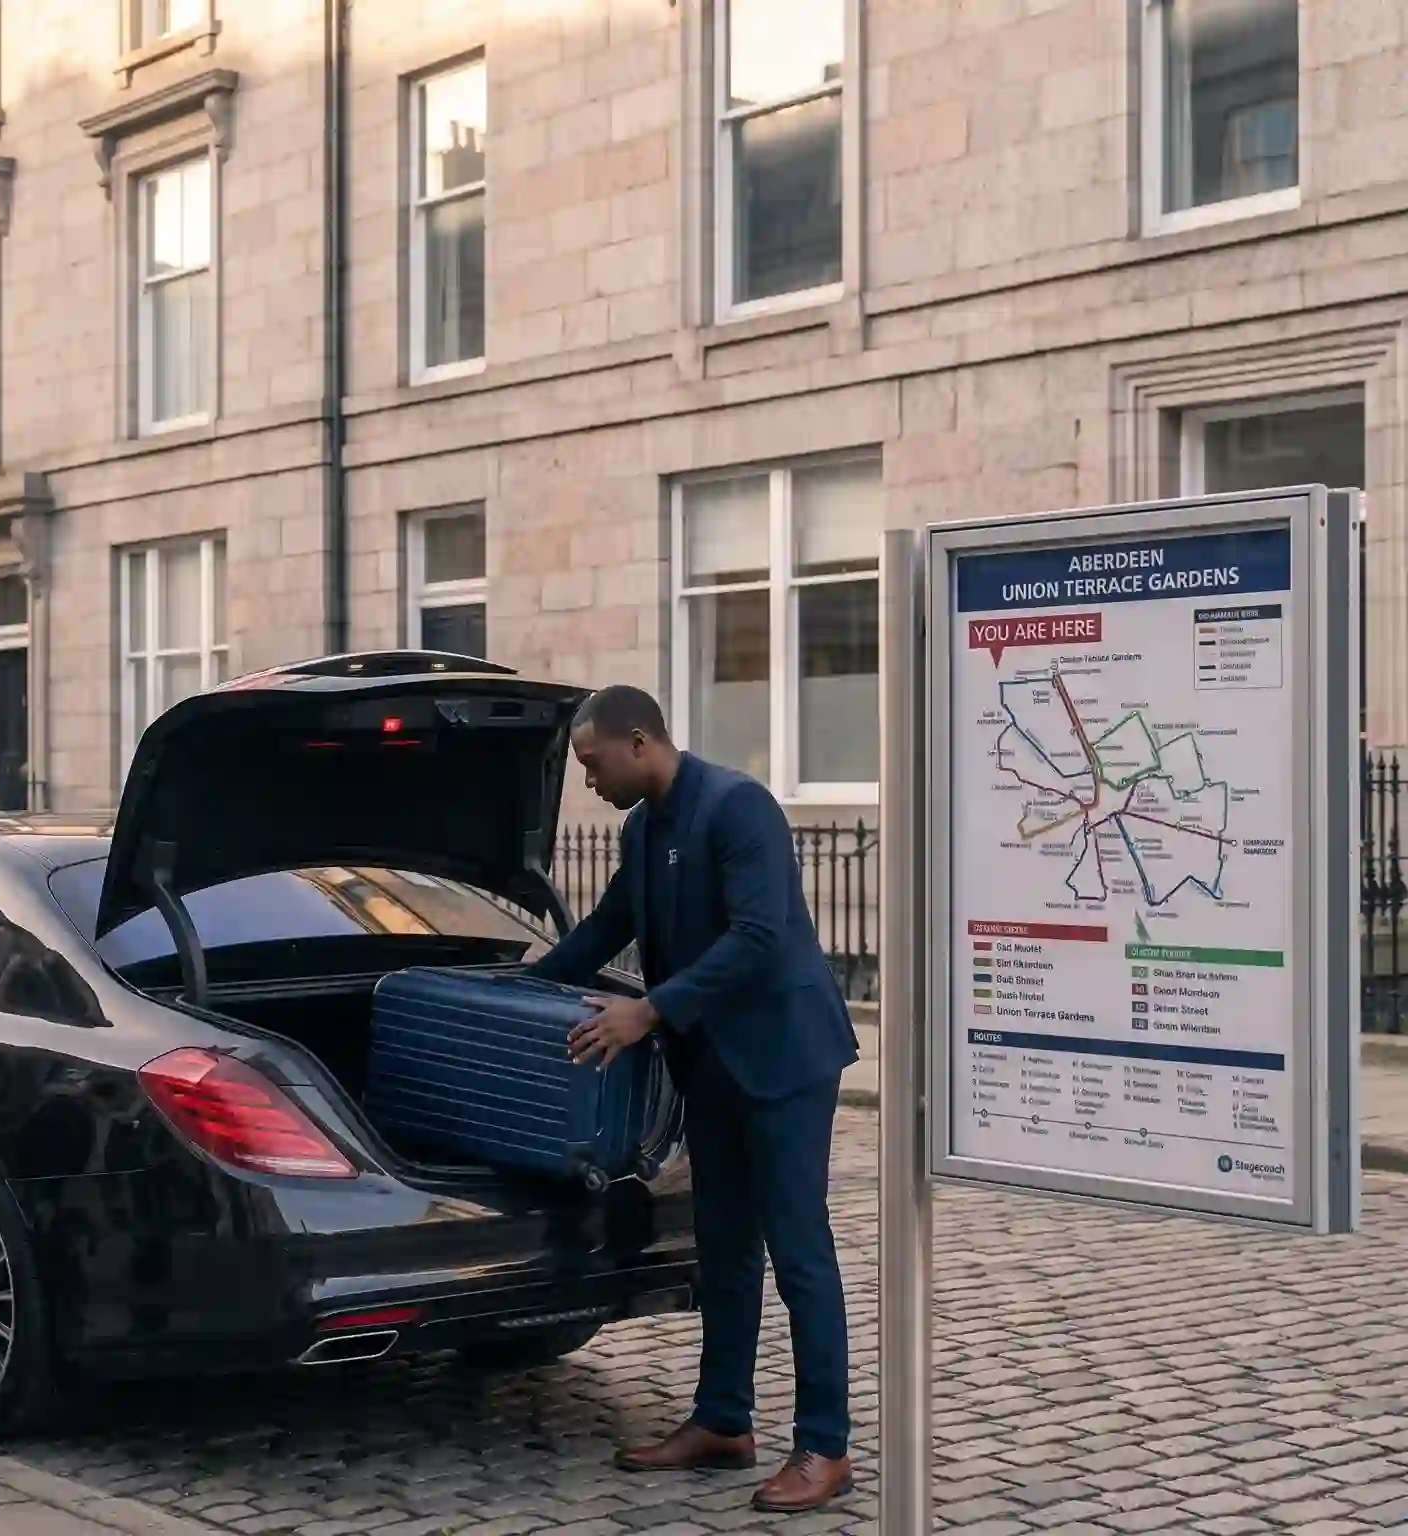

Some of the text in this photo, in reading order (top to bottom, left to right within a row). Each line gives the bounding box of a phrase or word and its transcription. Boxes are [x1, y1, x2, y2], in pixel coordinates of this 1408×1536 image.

[1068, 548, 1165, 573] ABERDEEN
[1002, 566, 1240, 601] UNION TERRACE GARDENS
[973, 619, 1096, 642] YOU ARE HERE
[996, 1005, 1022, 1017] Union
